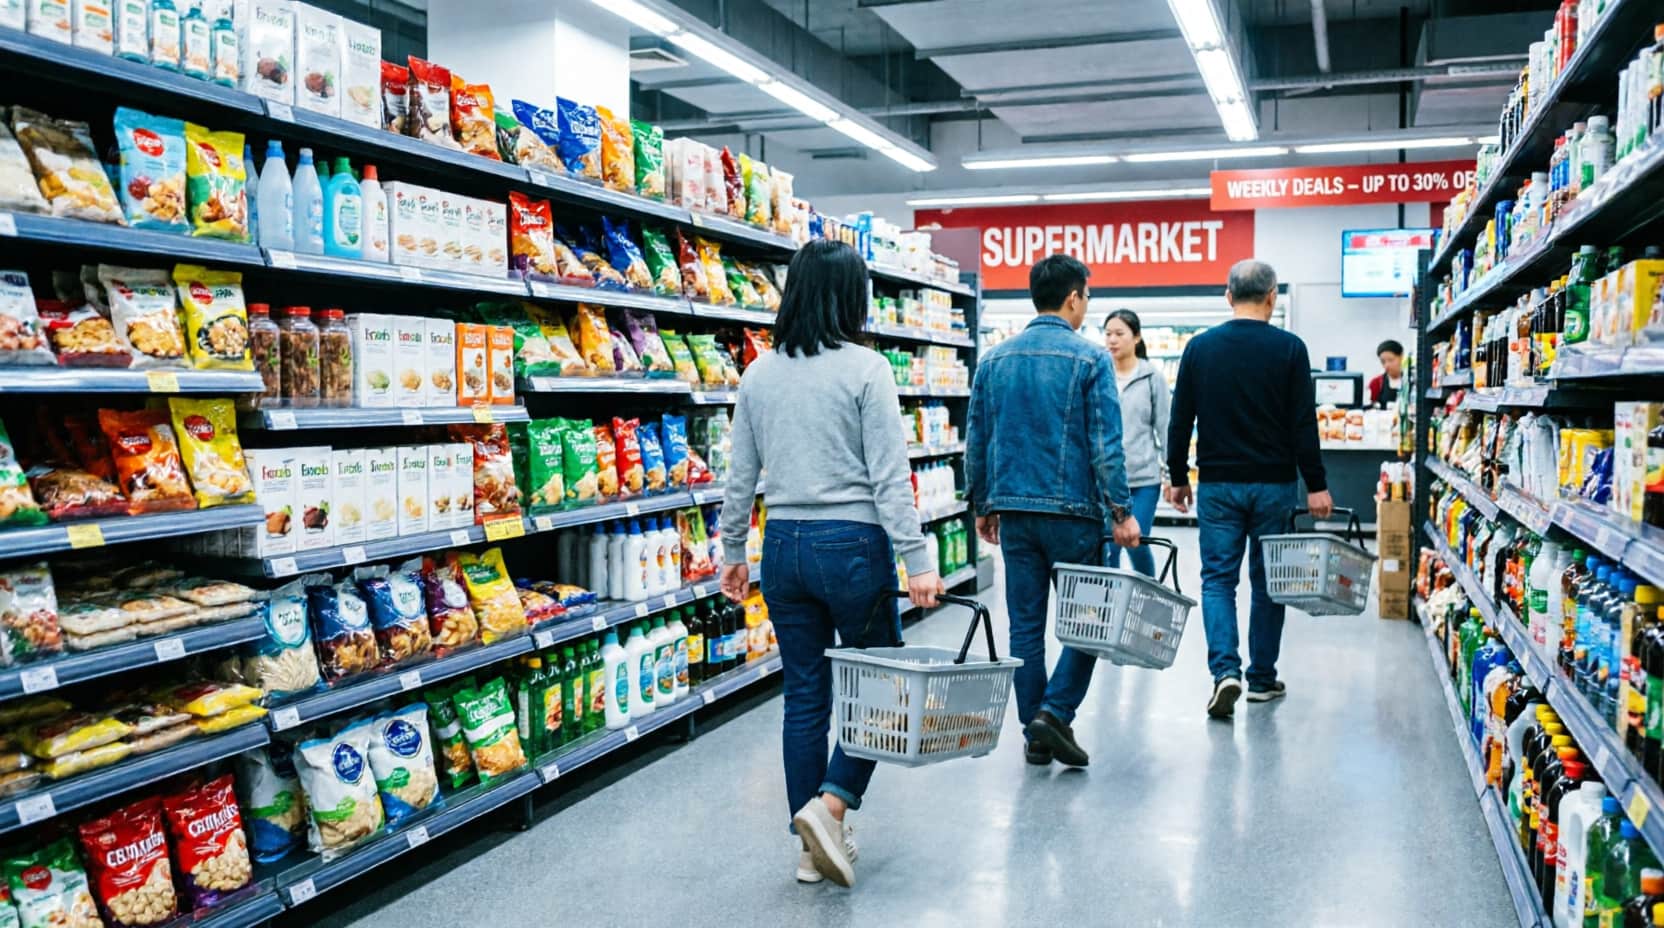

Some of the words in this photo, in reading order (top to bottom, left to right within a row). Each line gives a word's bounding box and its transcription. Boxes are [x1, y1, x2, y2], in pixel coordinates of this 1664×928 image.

[1227, 178, 1289, 199] WEEKLY
[1292, 176, 1344, 197] DEALS
[1362, 175, 1385, 194] UP
[1387, 174, 1409, 193] TO
[1413, 173, 1448, 192] 30%
[1453, 170, 1476, 190] OF
[982, 220, 1223, 267] SUPERMARKET
